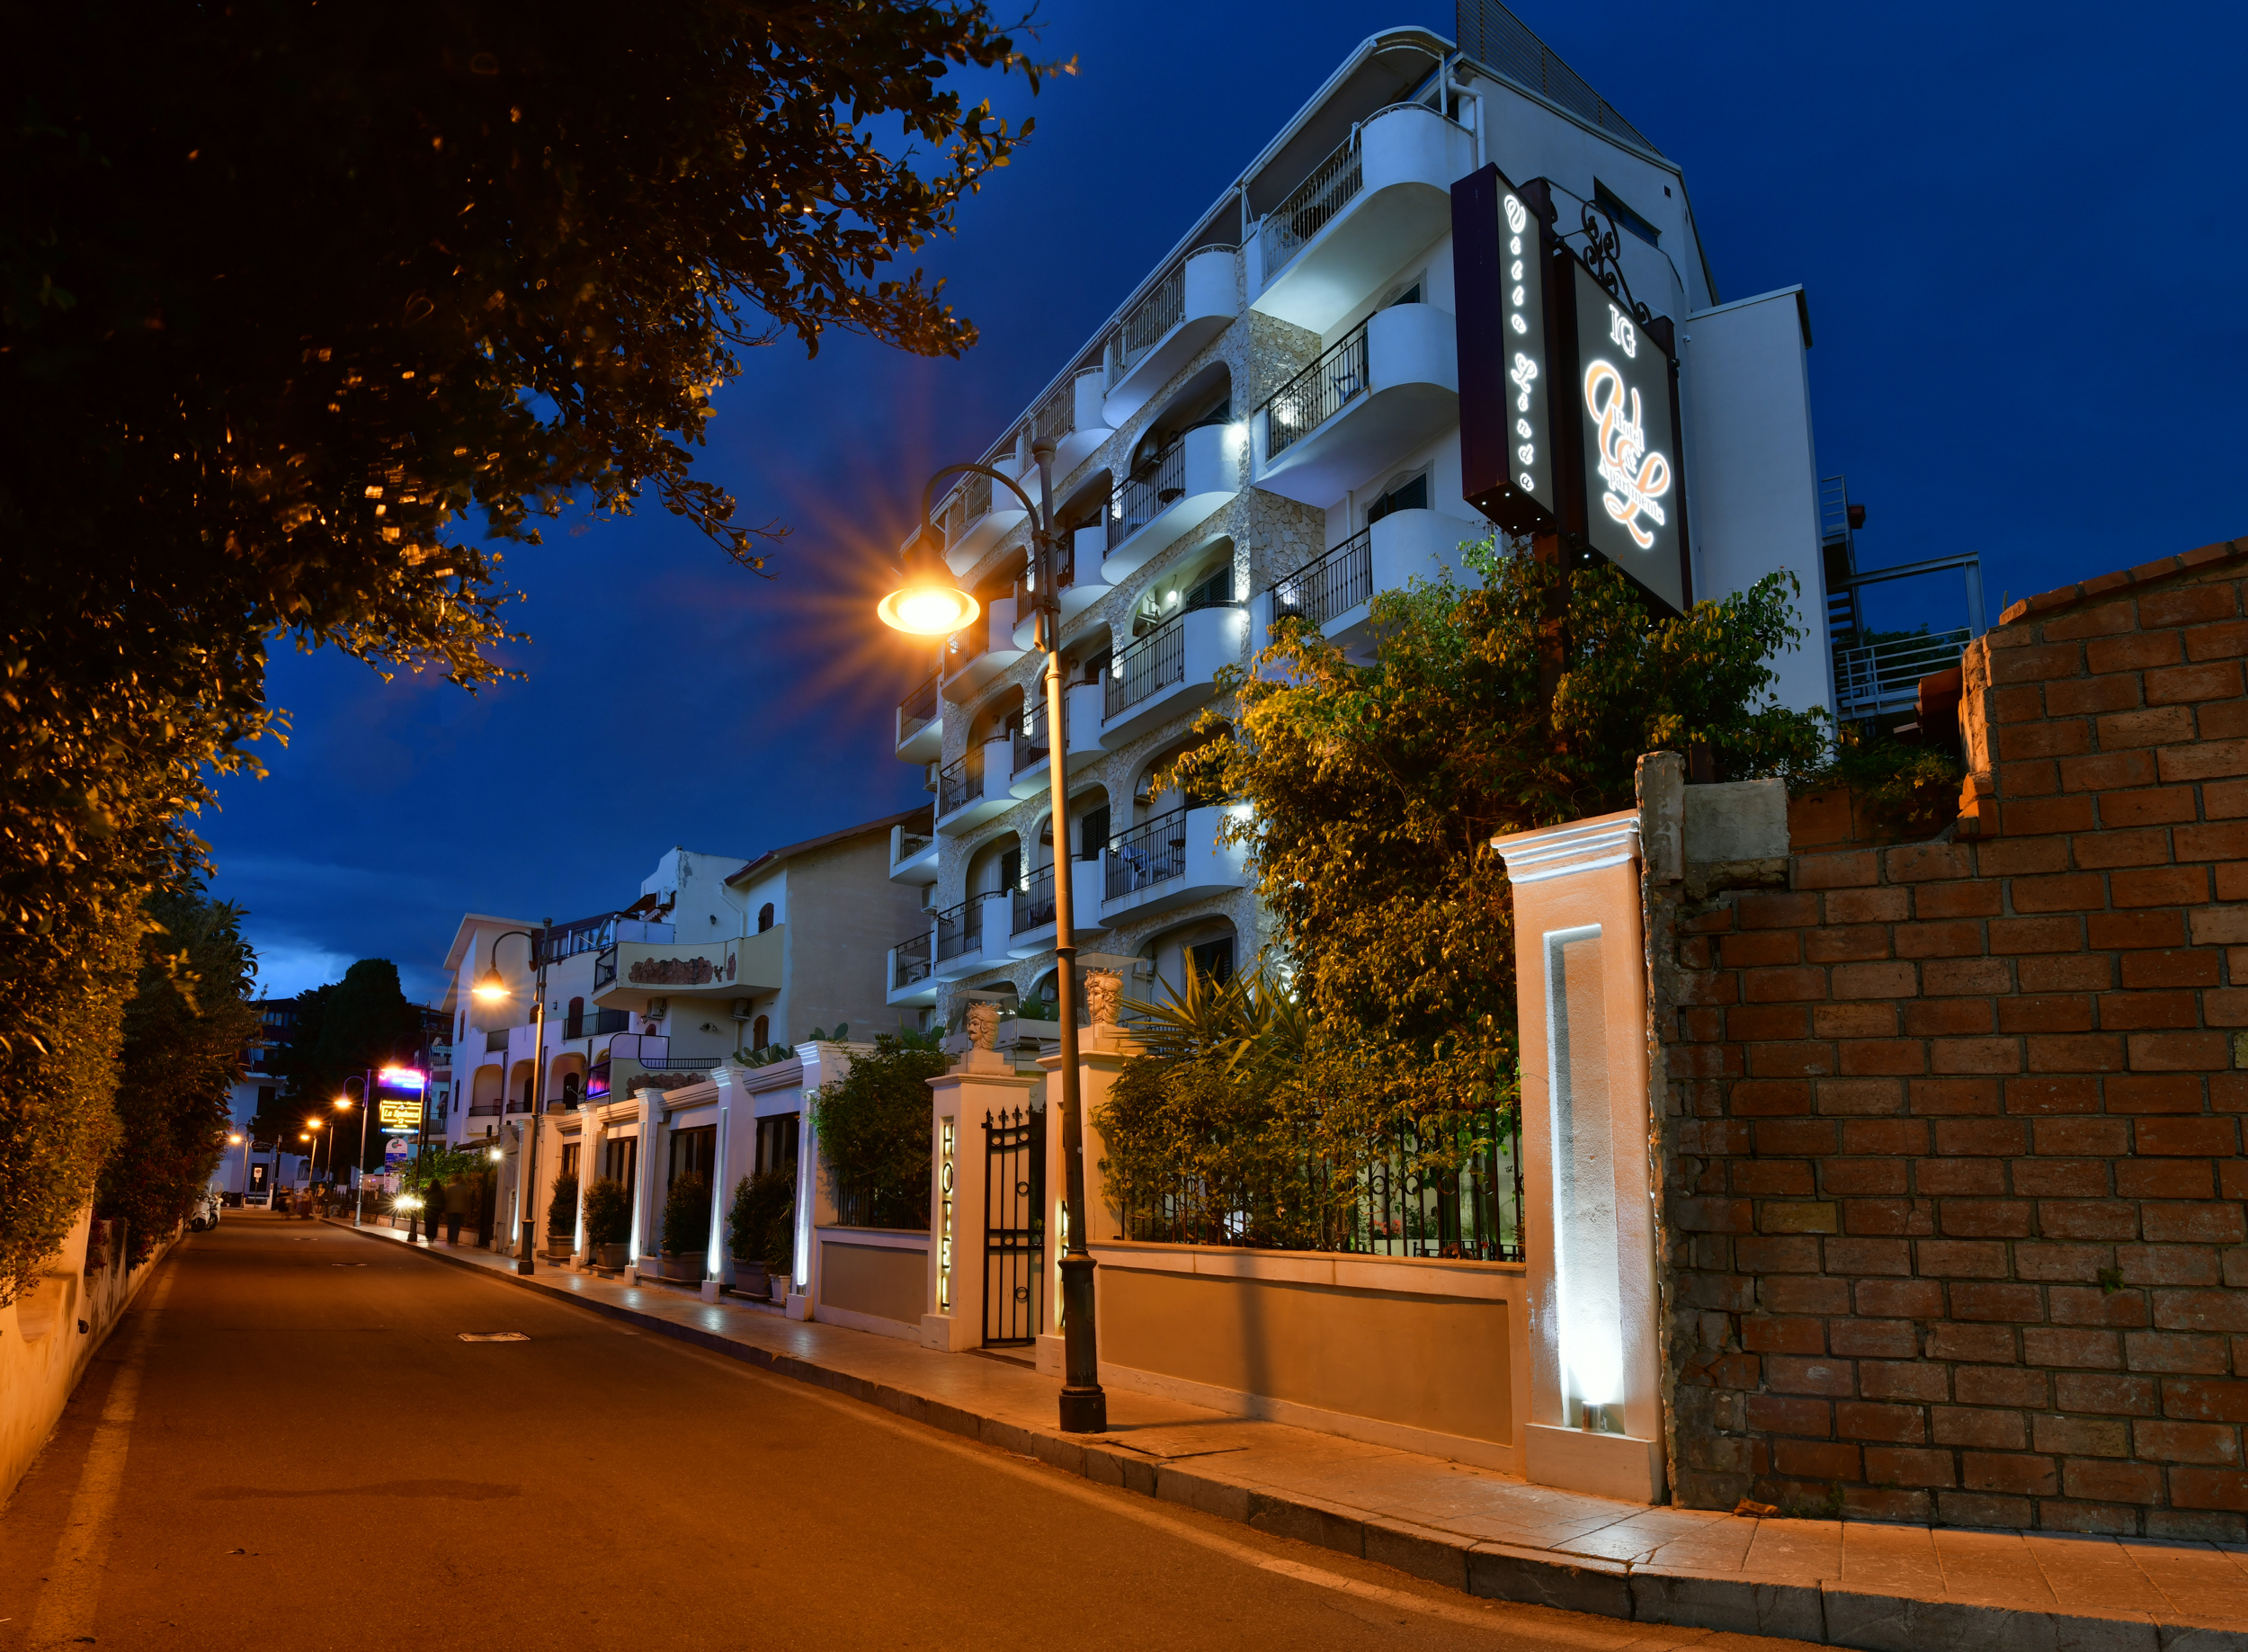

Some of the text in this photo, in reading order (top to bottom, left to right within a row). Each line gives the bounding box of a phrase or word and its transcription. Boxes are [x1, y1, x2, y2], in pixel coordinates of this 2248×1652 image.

[1504, 194, 1538, 492] Villa Linda
[1609, 302, 1637, 358] IG
[1610, 402, 1645, 452] Hotel
[1598, 453, 1665, 525] Apartments
[384, 1109, 393, 1117] La
[941, 1123, 955, 1308] HOTEL
